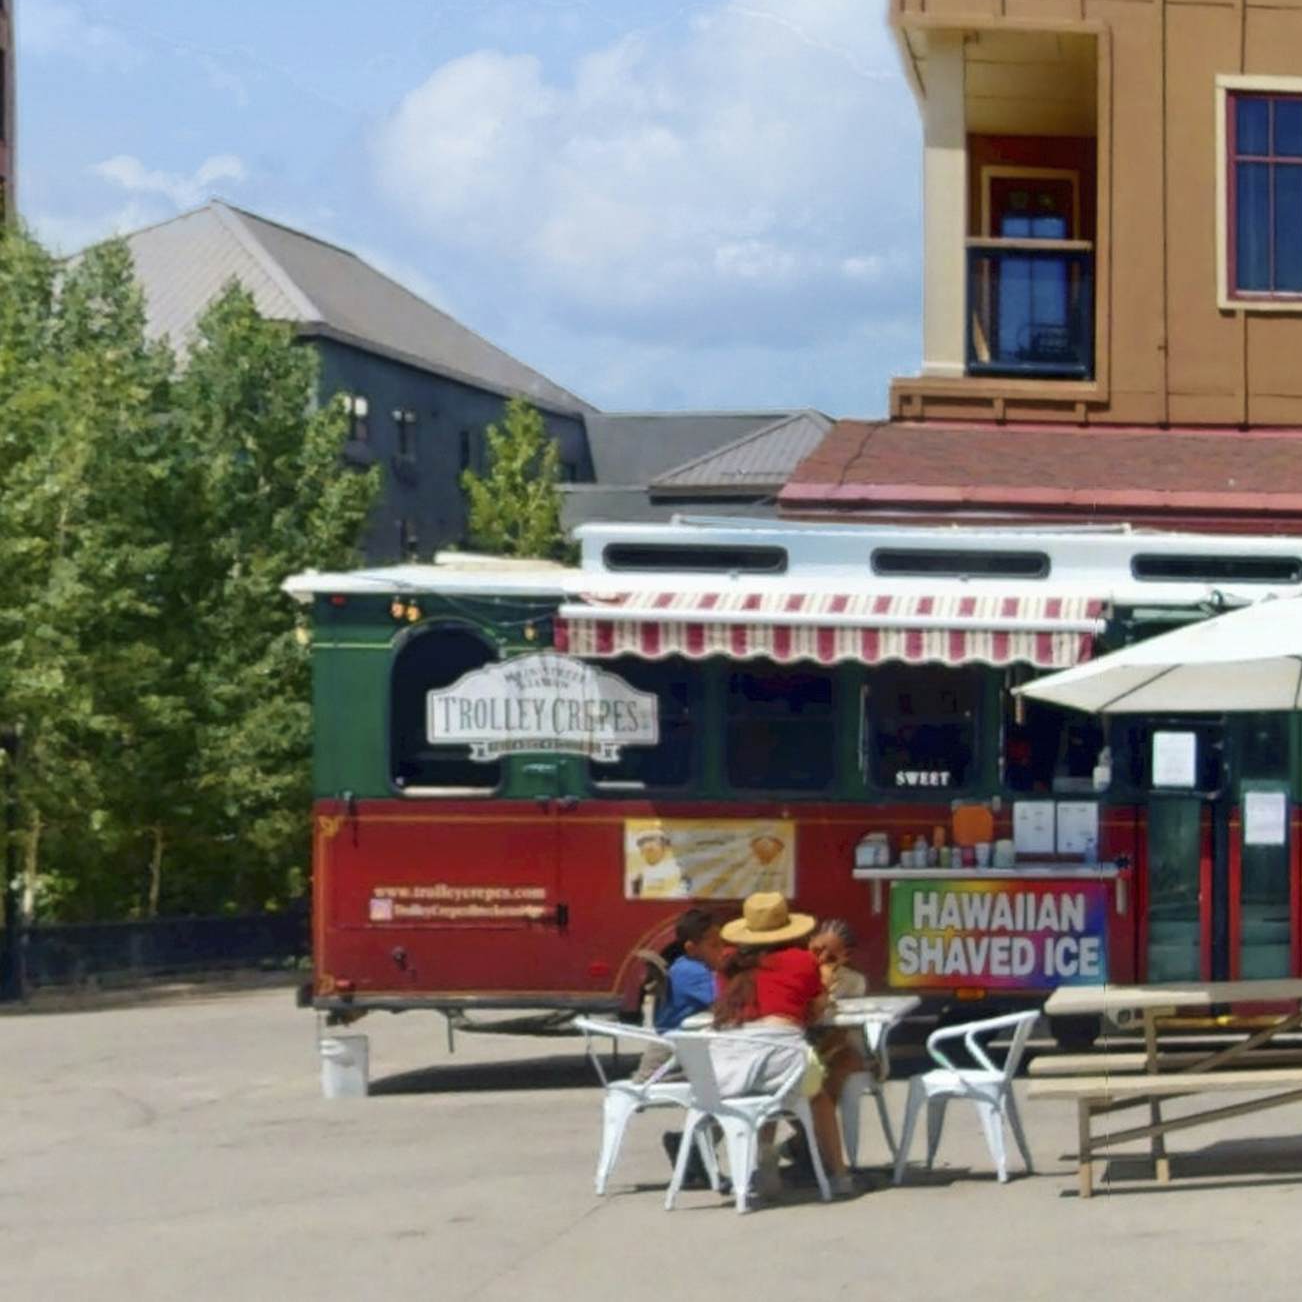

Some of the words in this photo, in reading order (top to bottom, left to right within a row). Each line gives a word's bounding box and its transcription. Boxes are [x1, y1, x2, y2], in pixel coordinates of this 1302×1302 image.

[438, 697, 545, 733] TROLLEY
[552, 698, 639, 734] CREPES
[896, 771, 950, 787] SWEET
[913, 891, 1085, 931] HAWAIIAN
[898, 935, 1035, 977] SHAVED
[1044, 936, 1100, 977] ICE
